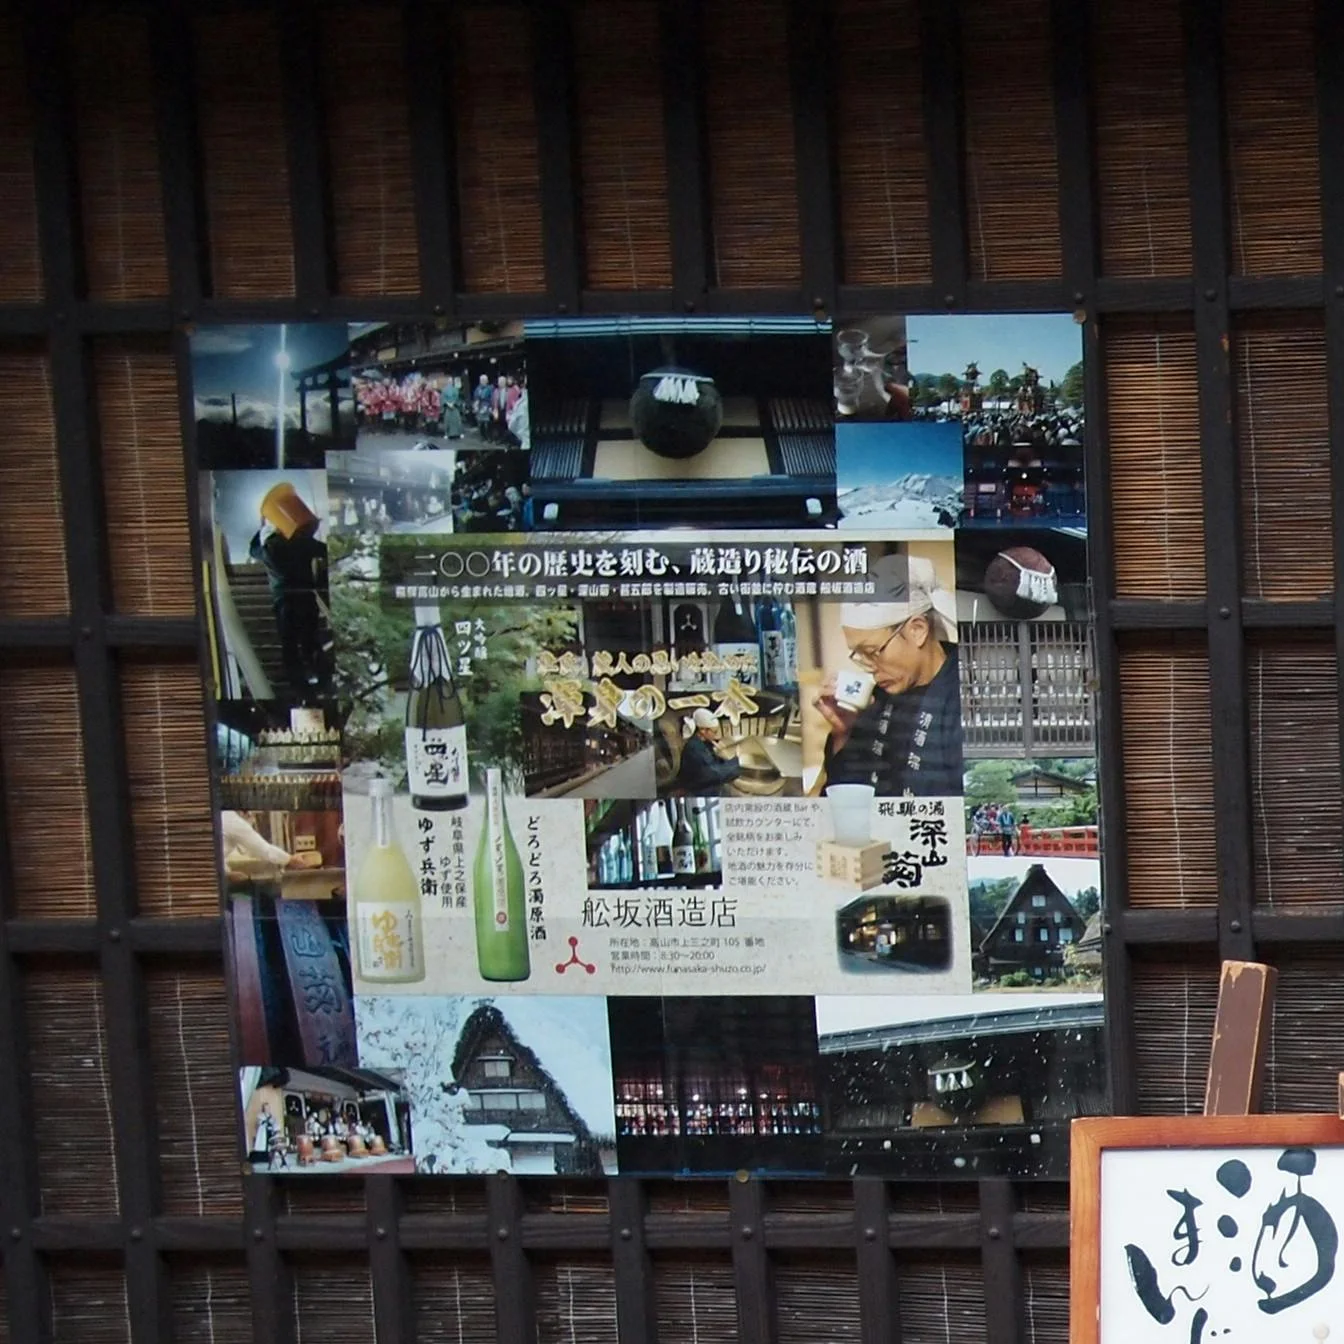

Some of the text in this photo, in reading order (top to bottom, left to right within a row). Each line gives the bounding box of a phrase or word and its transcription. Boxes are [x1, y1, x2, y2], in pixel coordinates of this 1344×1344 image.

[455, 621, 474, 676] 四ツ星
[539, 678, 760, 729] 渾身の一本
[418, 817, 438, 896] ゆず兵衛
[527, 816, 547, 940] どろどろ濁原酒
[882, 819, 949, 888] 深山菊
[440, 856, 454, 908] ゆず使用
[582, 896, 738, 928] 舩坂酒造店
